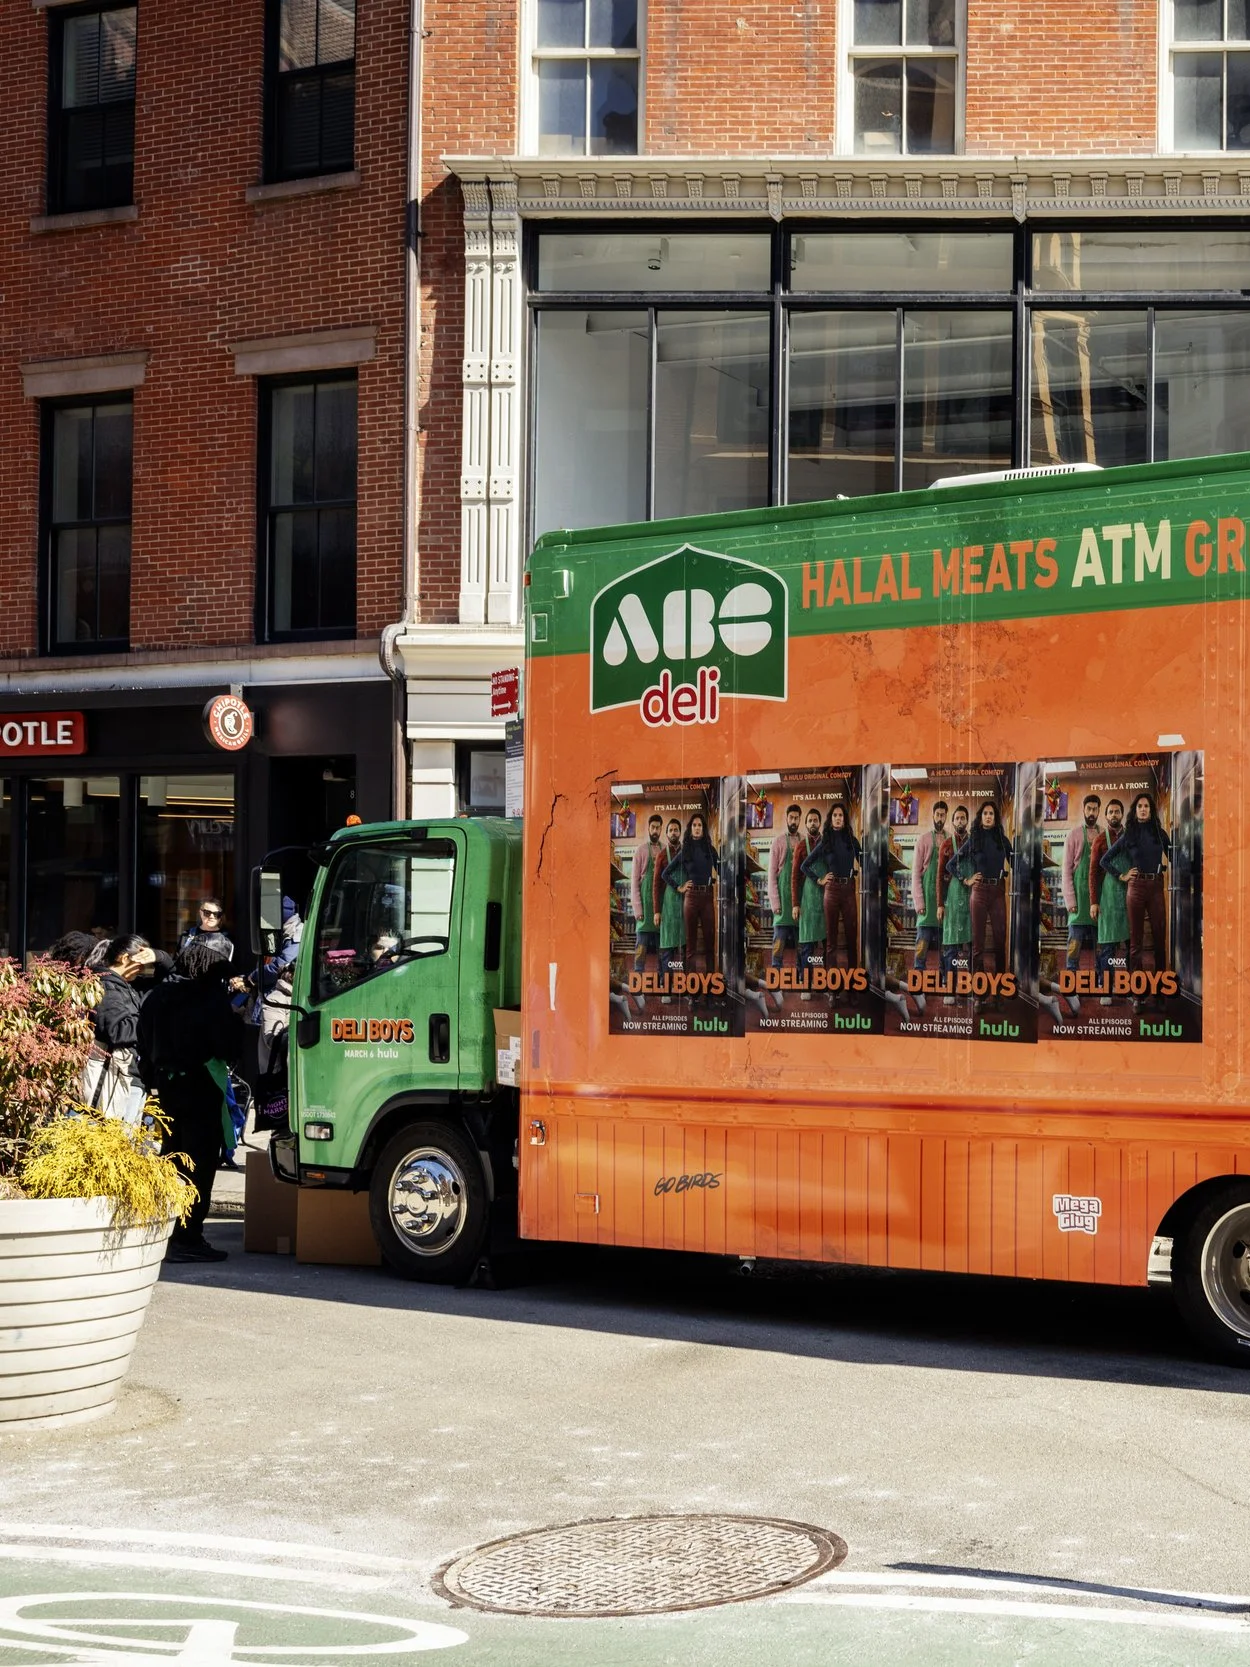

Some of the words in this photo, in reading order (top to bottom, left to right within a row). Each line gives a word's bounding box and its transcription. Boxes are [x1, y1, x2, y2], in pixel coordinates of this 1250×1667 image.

[802, 552, 921, 609] HALAL
[932, 538, 1059, 598] MEATS
[1071, 519, 1171, 588] ATM
[603, 582, 772, 666] ABC
[641, 667, 720, 726] deli
[213, 698, 249, 720] CHIPOTLE
[0, 720, 74, 747] OTLE
[1090, 783, 1103, 791] IT'S
[1107, 957, 1126, 966] ONYX
[628, 971, 670, 994] DELI
[672, 972, 725, 995] BOYS
[765, 967, 809, 990] DELI
[811, 967, 868, 991] BOYS
[907, 969, 954, 994] DELI
[956, 971, 1016, 997] BOYS
[1059, 969, 1110, 994] DELI
[1113, 970, 1178, 995] BOYS
[331, 1018, 368, 1043] DELI
[369, 1018, 415, 1044] BOYS
[623, 1021, 641, 1030] NOW
[642, 1022, 687, 1031] STREAMING
[693, 1016, 728, 1031] hulu
[760, 1019, 779, 1027] NOW
[781, 1019, 828, 1028] STREAMING
[834, 1013, 871, 1030] hulu
[900, 1022, 920, 1031] NOW
[922, 1023, 973, 1034] STREAMING
[980, 1018, 1020, 1037] hulu
[1052, 1025, 1075, 1034] NOW
[1077, 1025, 1132, 1036] STREAMING
[1139, 1019, 1182, 1037] hulu
[344, 1049, 368, 1058] MARCH
[369, 1050, 374, 1058] 6
[377, 1048, 399, 1058] hulu
[263, 1104, 288, 1115] MARKE
[654, 1176, 676, 1196] GO
[675, 1173, 723, 1193] BIRDS
[1054, 1196, 1099, 1214] Mega
[1059, 1213, 1095, 1232] Glug
